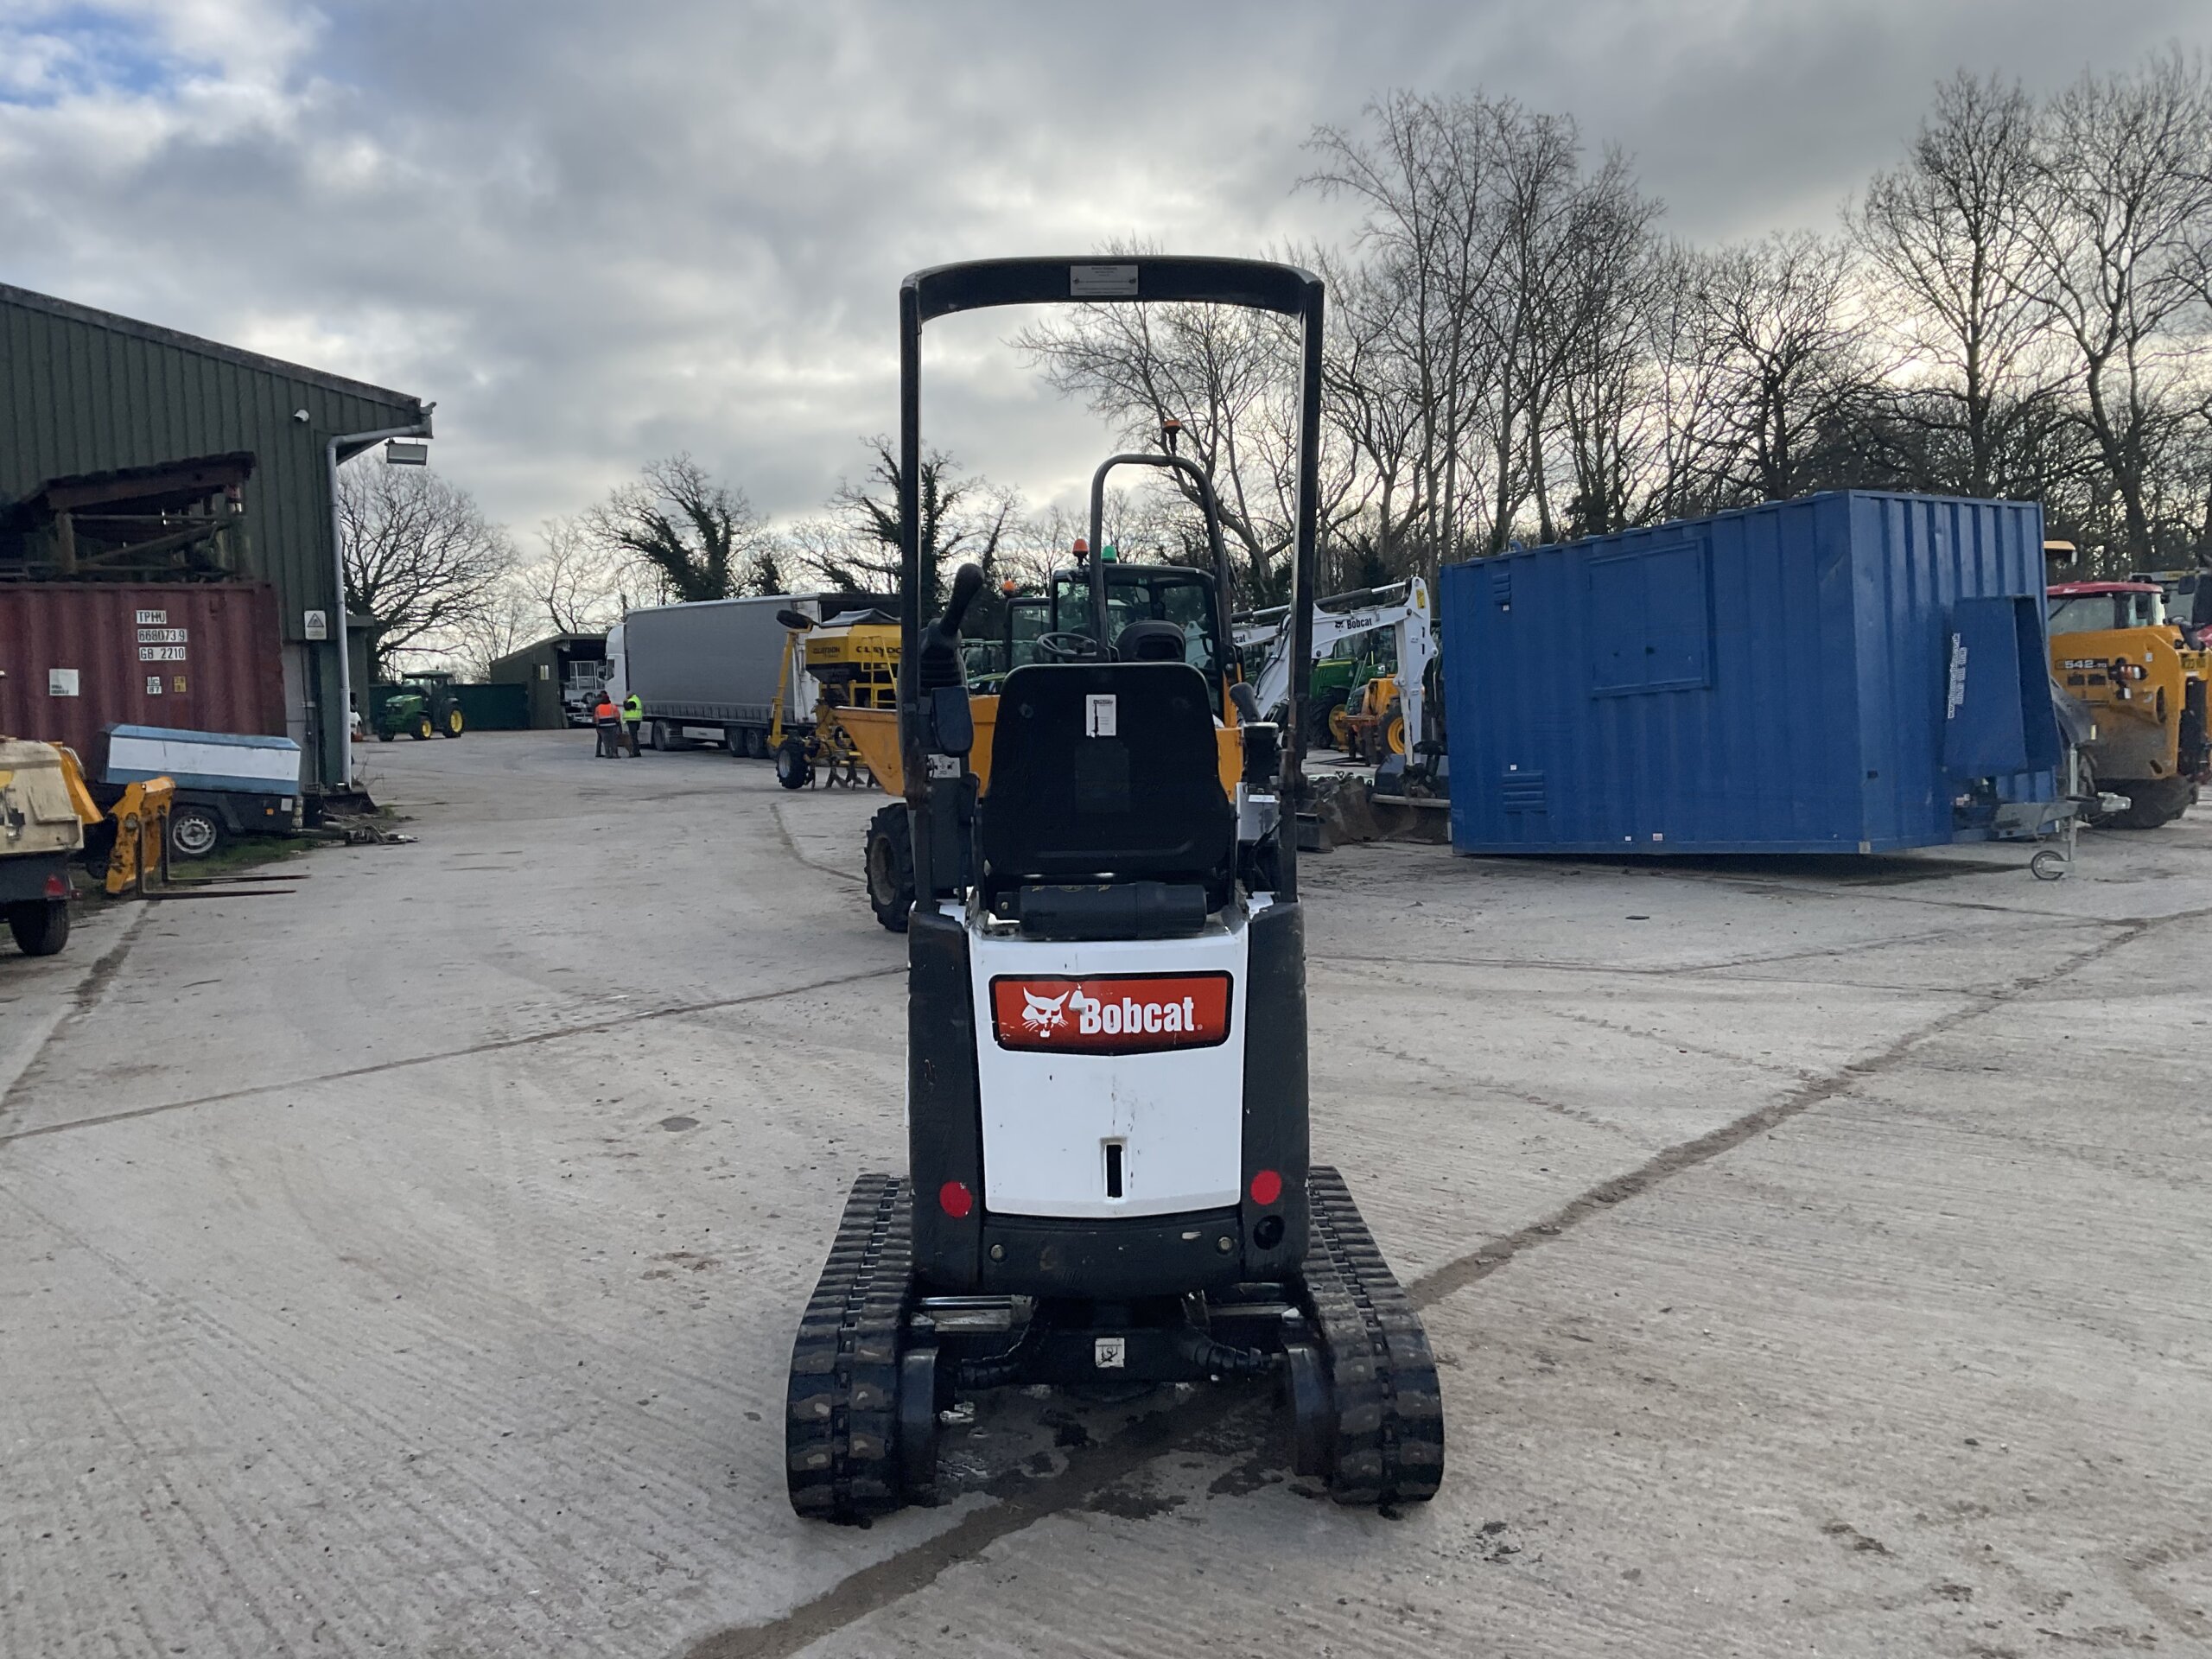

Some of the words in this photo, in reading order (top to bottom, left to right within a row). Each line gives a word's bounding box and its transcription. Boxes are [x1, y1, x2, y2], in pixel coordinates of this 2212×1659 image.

[138, 611, 166, 623] TPHU
[1347, 618, 1372, 629] Bobcat
[140, 648, 154, 659] GB
[160, 648, 185, 659] 2210
[1079, 995, 1195, 1035] Bobcat
